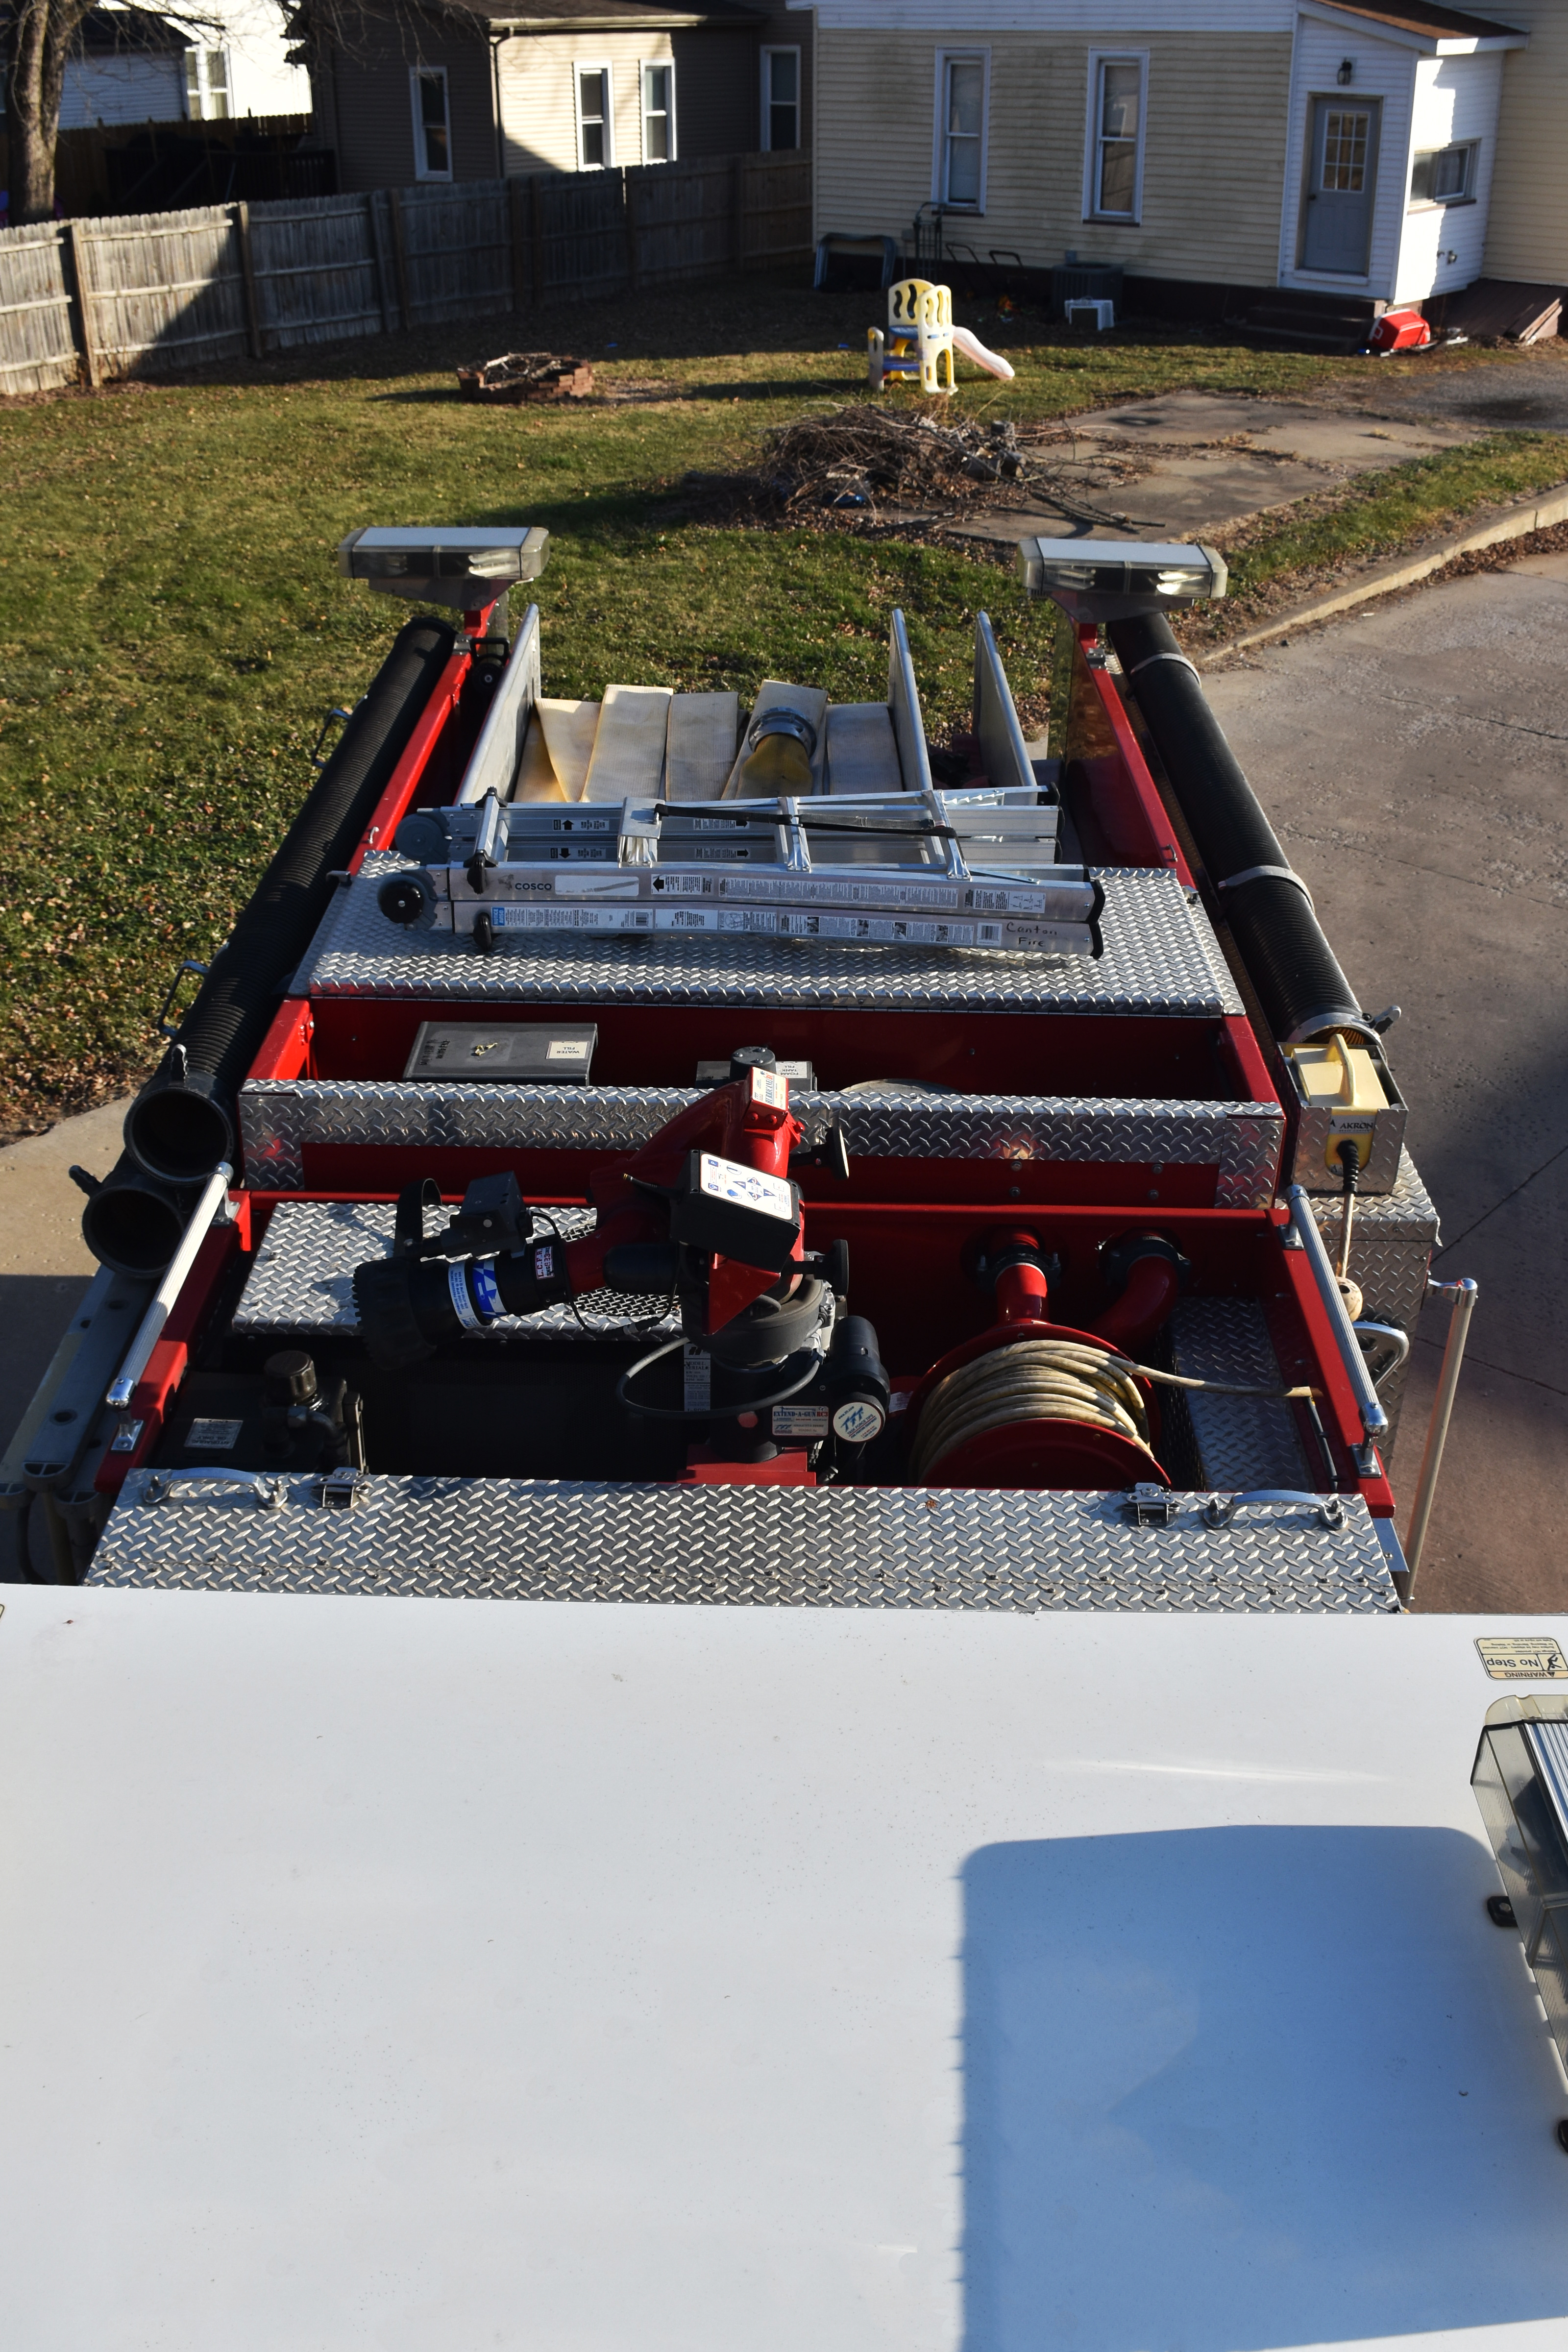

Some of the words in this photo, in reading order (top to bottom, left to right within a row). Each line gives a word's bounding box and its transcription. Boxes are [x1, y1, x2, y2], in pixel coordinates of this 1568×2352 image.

[1006, 921, 1057, 935] Canton
[1018, 937, 1046, 947] Fire
[840, 1406, 864, 1432] TFT
[855, 1419, 866, 1429] FORCE
[1487, 1658, 1517, 1667] Step
